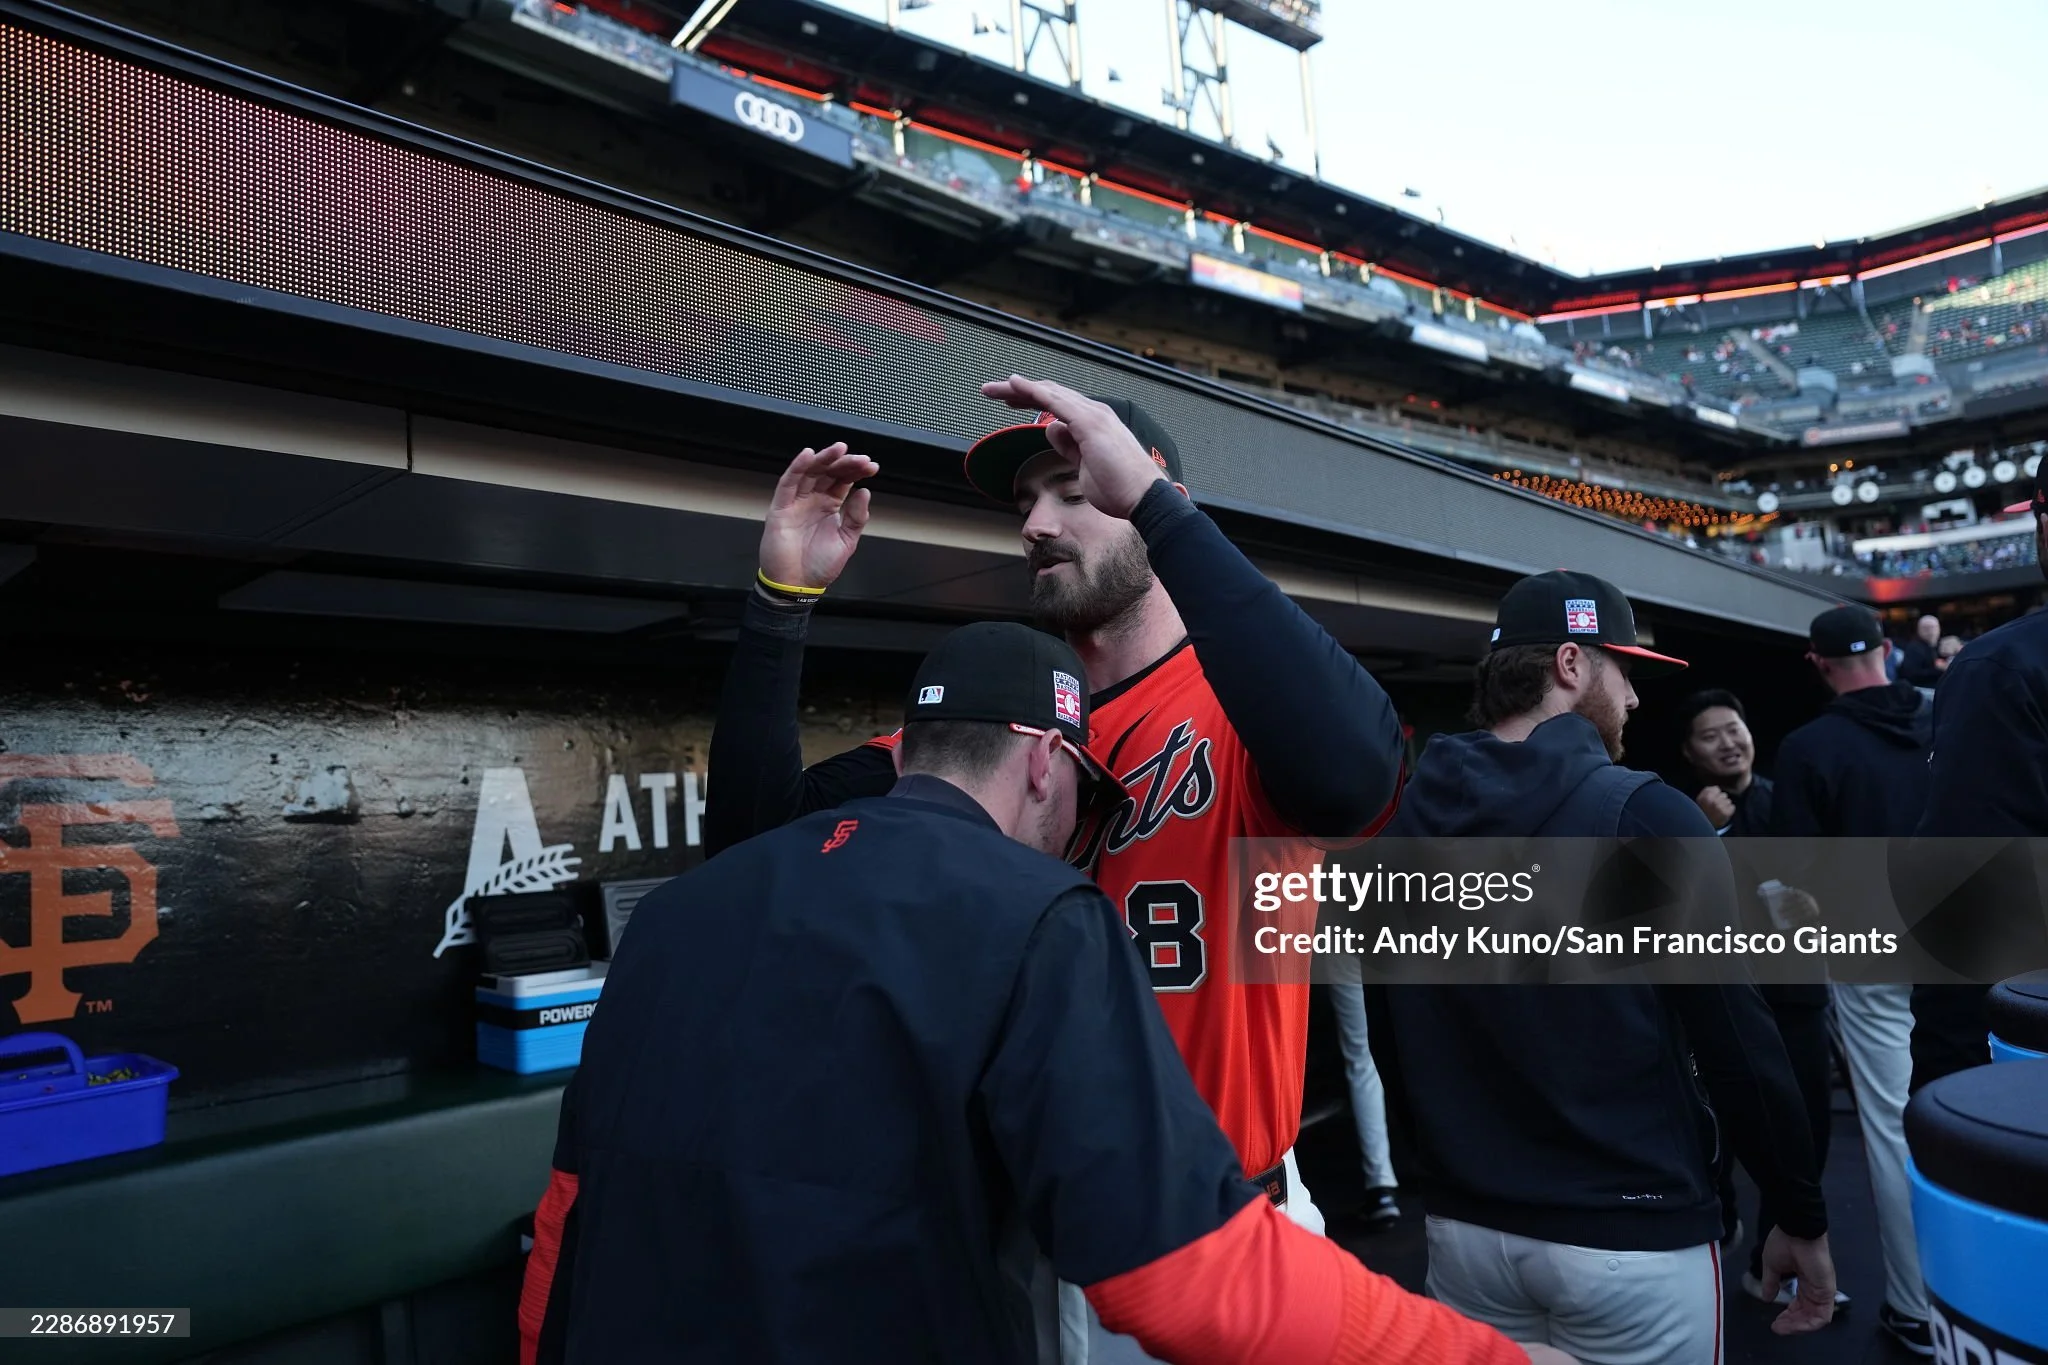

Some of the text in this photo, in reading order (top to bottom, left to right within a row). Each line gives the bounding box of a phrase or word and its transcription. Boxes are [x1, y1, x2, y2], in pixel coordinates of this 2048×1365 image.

[1125, 880, 1206, 993] 8
[85, 999, 113, 1014] TM
[539, 1002, 598, 1025] POWER
